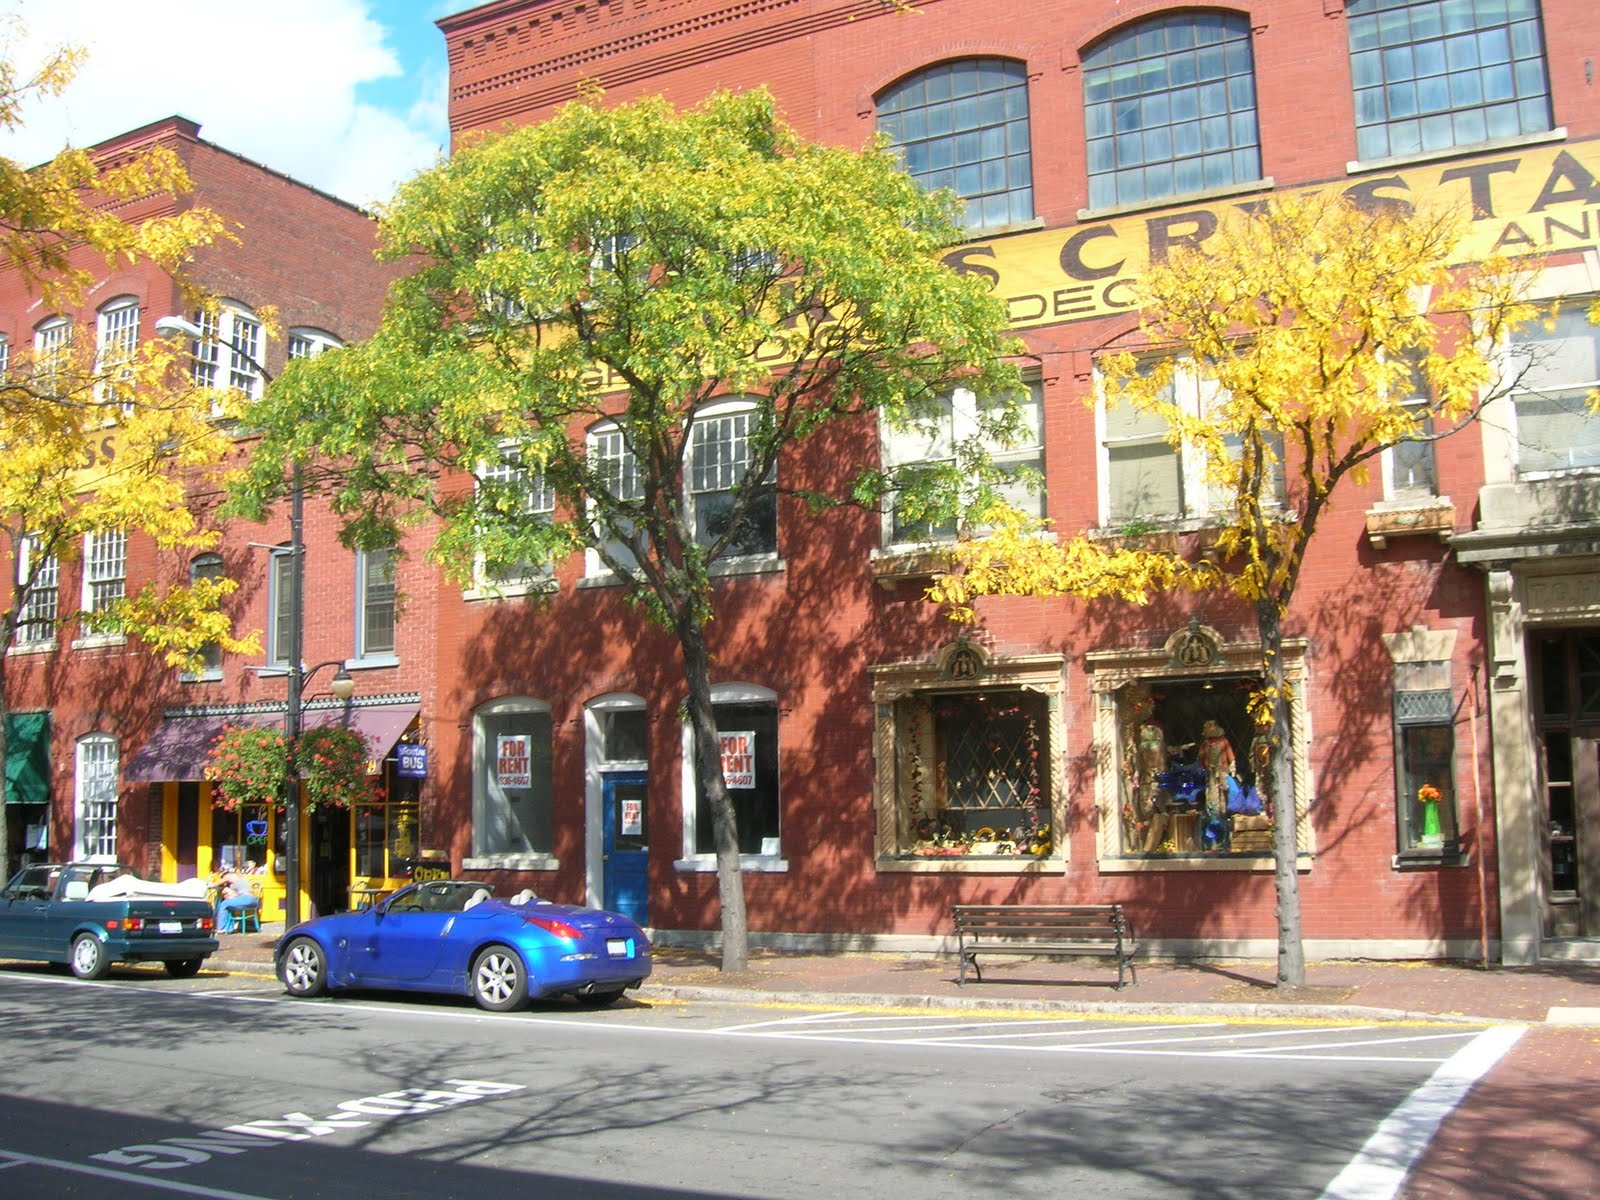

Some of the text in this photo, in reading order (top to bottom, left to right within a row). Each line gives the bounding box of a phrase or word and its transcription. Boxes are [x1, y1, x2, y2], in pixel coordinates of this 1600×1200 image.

[1488, 208, 1600, 254] AN
[502, 740, 525, 757] FOR
[720, 736, 748, 755] FOR
[402, 756, 424, 769] BUS
[498, 757, 529, 774] RENT
[720, 754, 752, 773] RENT
[725, 775, 752, 785] 6-4607
[626, 802, 639, 811] FOR
[624, 811, 640, 820] RENT
